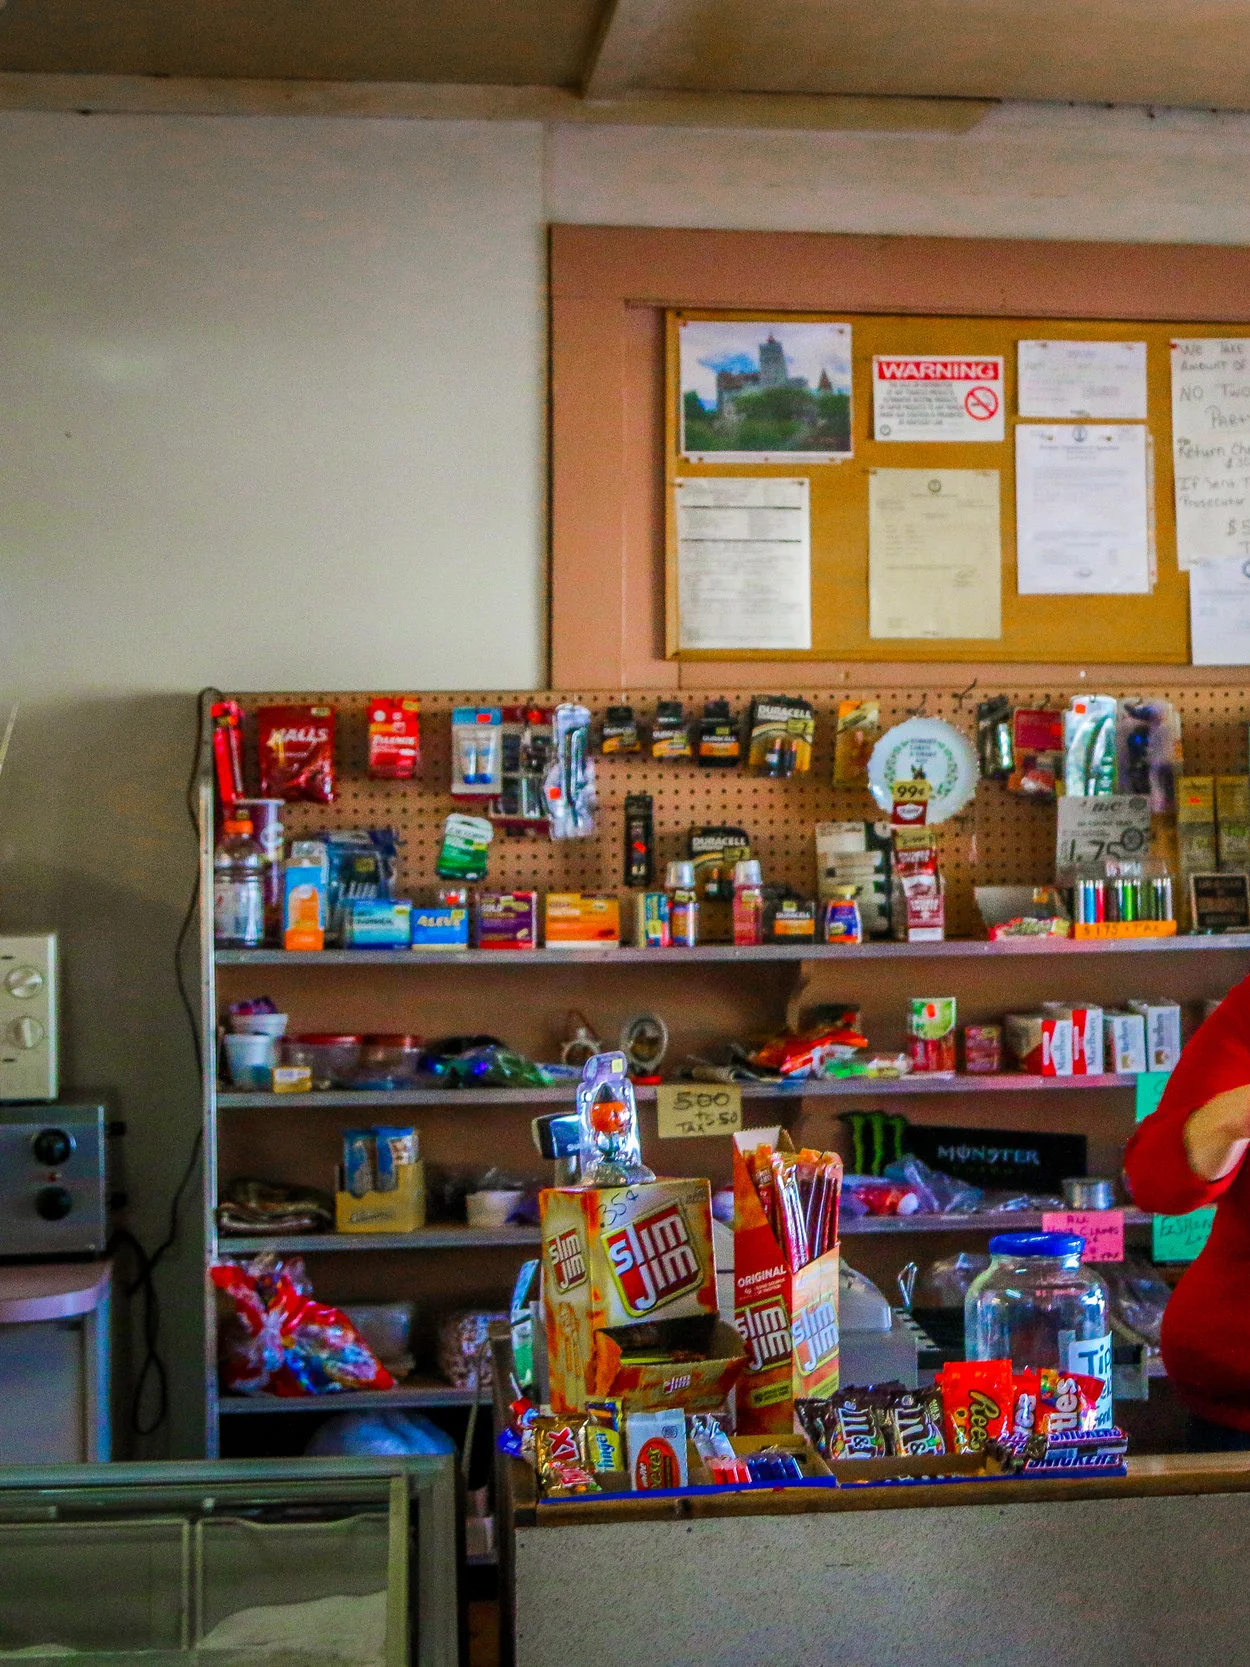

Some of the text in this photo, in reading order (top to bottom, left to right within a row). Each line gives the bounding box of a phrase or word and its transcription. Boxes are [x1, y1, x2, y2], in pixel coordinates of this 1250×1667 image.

[881, 362, 995, 379] WARNING
[757, 704, 812, 719] DURACELL
[937, 1144, 1041, 1165] MONSTER
[737, 1264, 788, 1288] ORIGINAL
